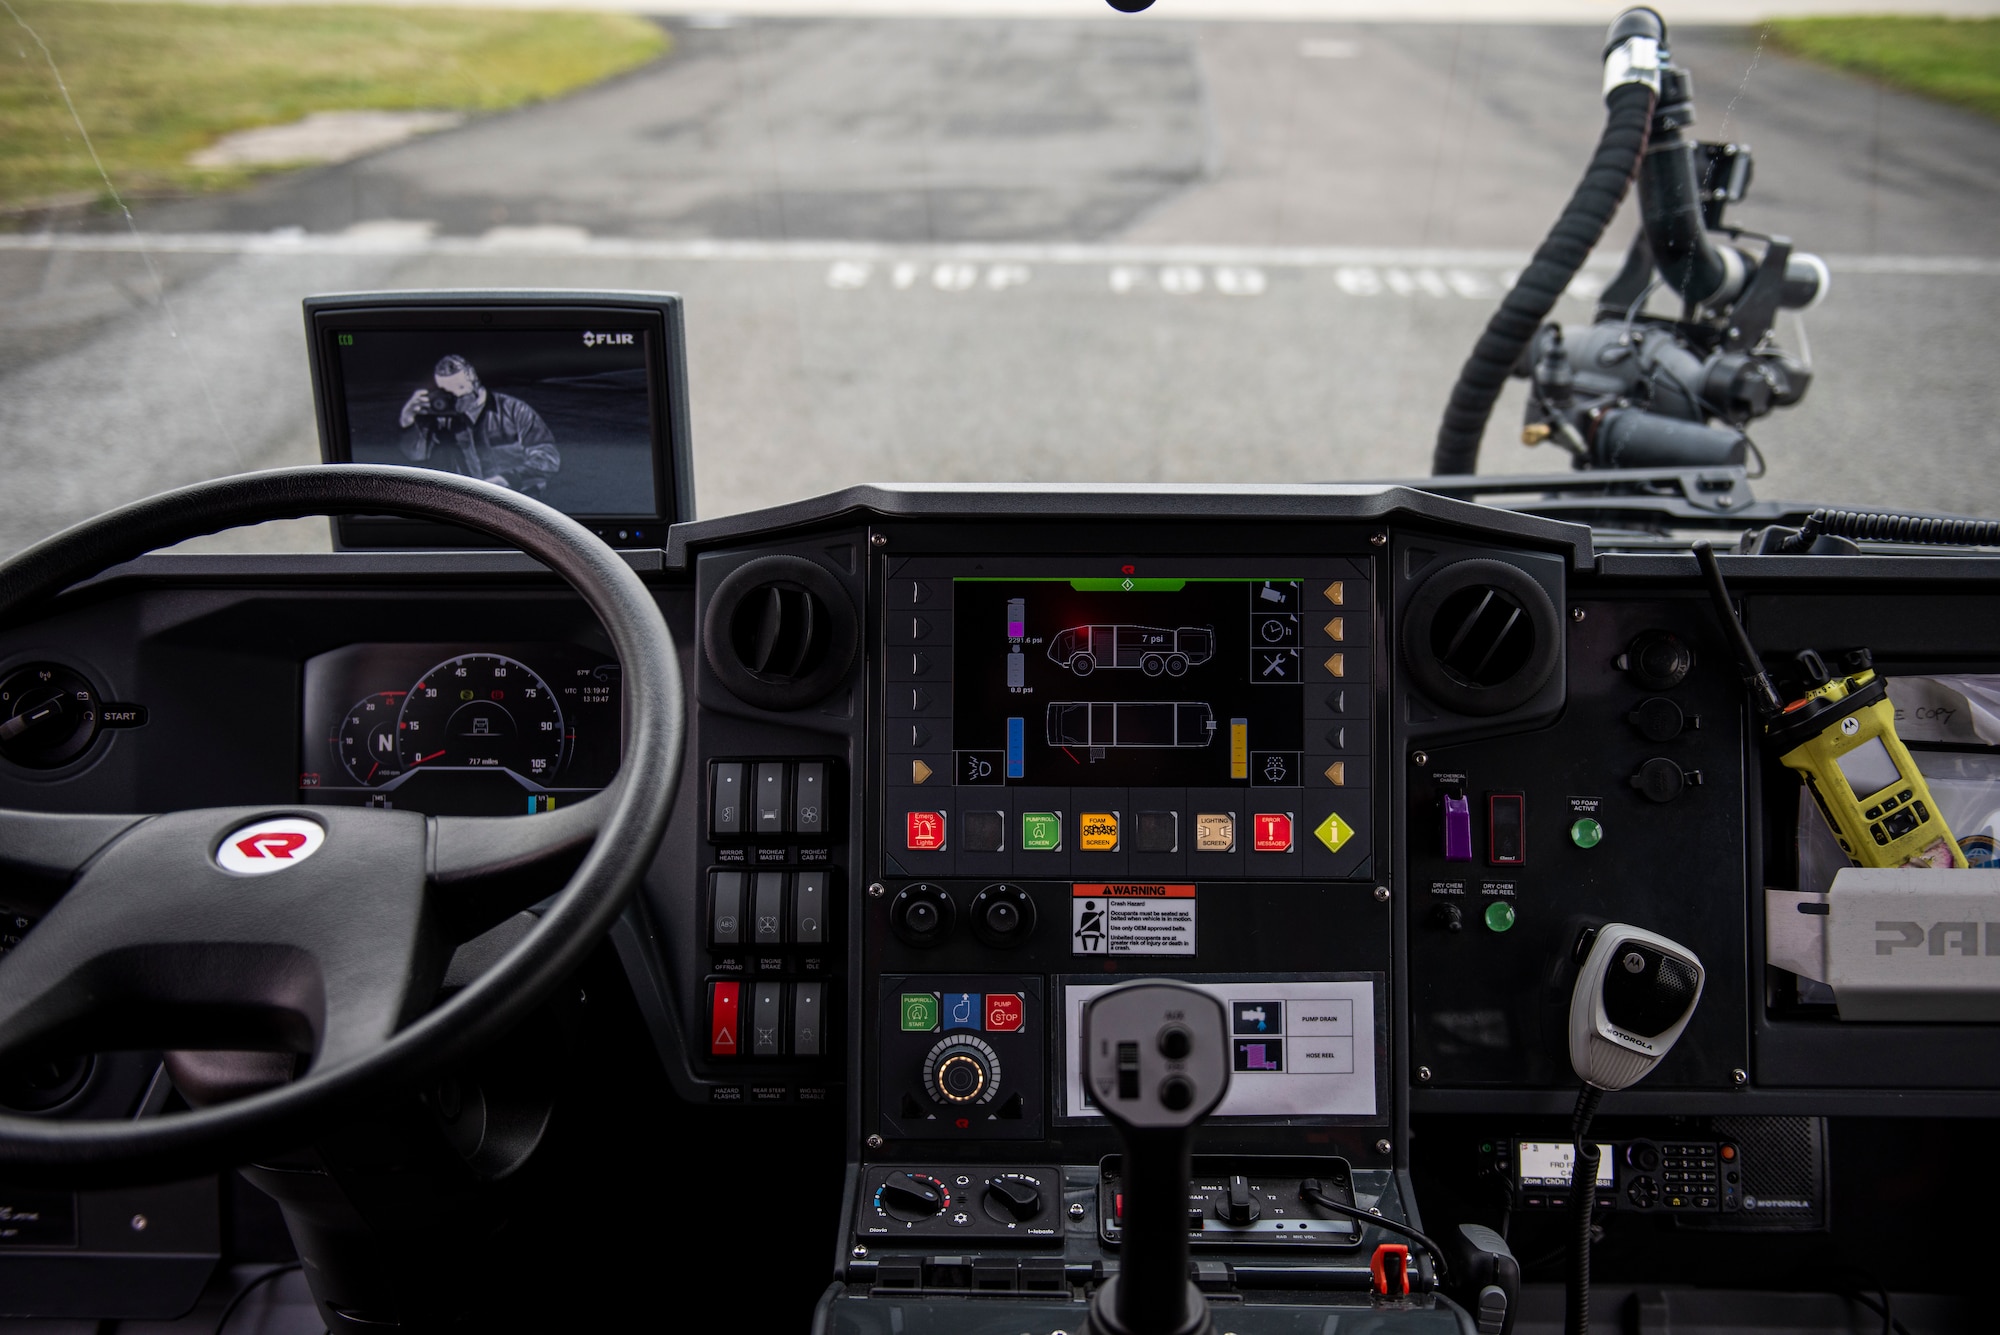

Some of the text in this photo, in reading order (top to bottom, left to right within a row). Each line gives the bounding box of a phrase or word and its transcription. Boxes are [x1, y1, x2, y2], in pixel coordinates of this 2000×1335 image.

[596, 334, 634, 344] FLIR
[1142, 634, 1164, 644] 7 psi
[455, 668, 467, 677] 45
[494, 668, 506, 677] 60
[425, 688, 437, 698] 30
[525, 689, 536, 698] 75
[1022, 686, 1033, 694] psi
[104, 712, 136, 721] START
[1916, 707, 1956, 724] COPY
[409, 721, 419, 730] 15
[541, 722, 552, 730] 90
[379, 734, 392, 751] N
[415, 752, 422, 762] 0
[531, 759, 546, 768] 105
[1113, 886, 1166, 895] WARNING
[1606, 1028, 1653, 1050] MOTOROLA
